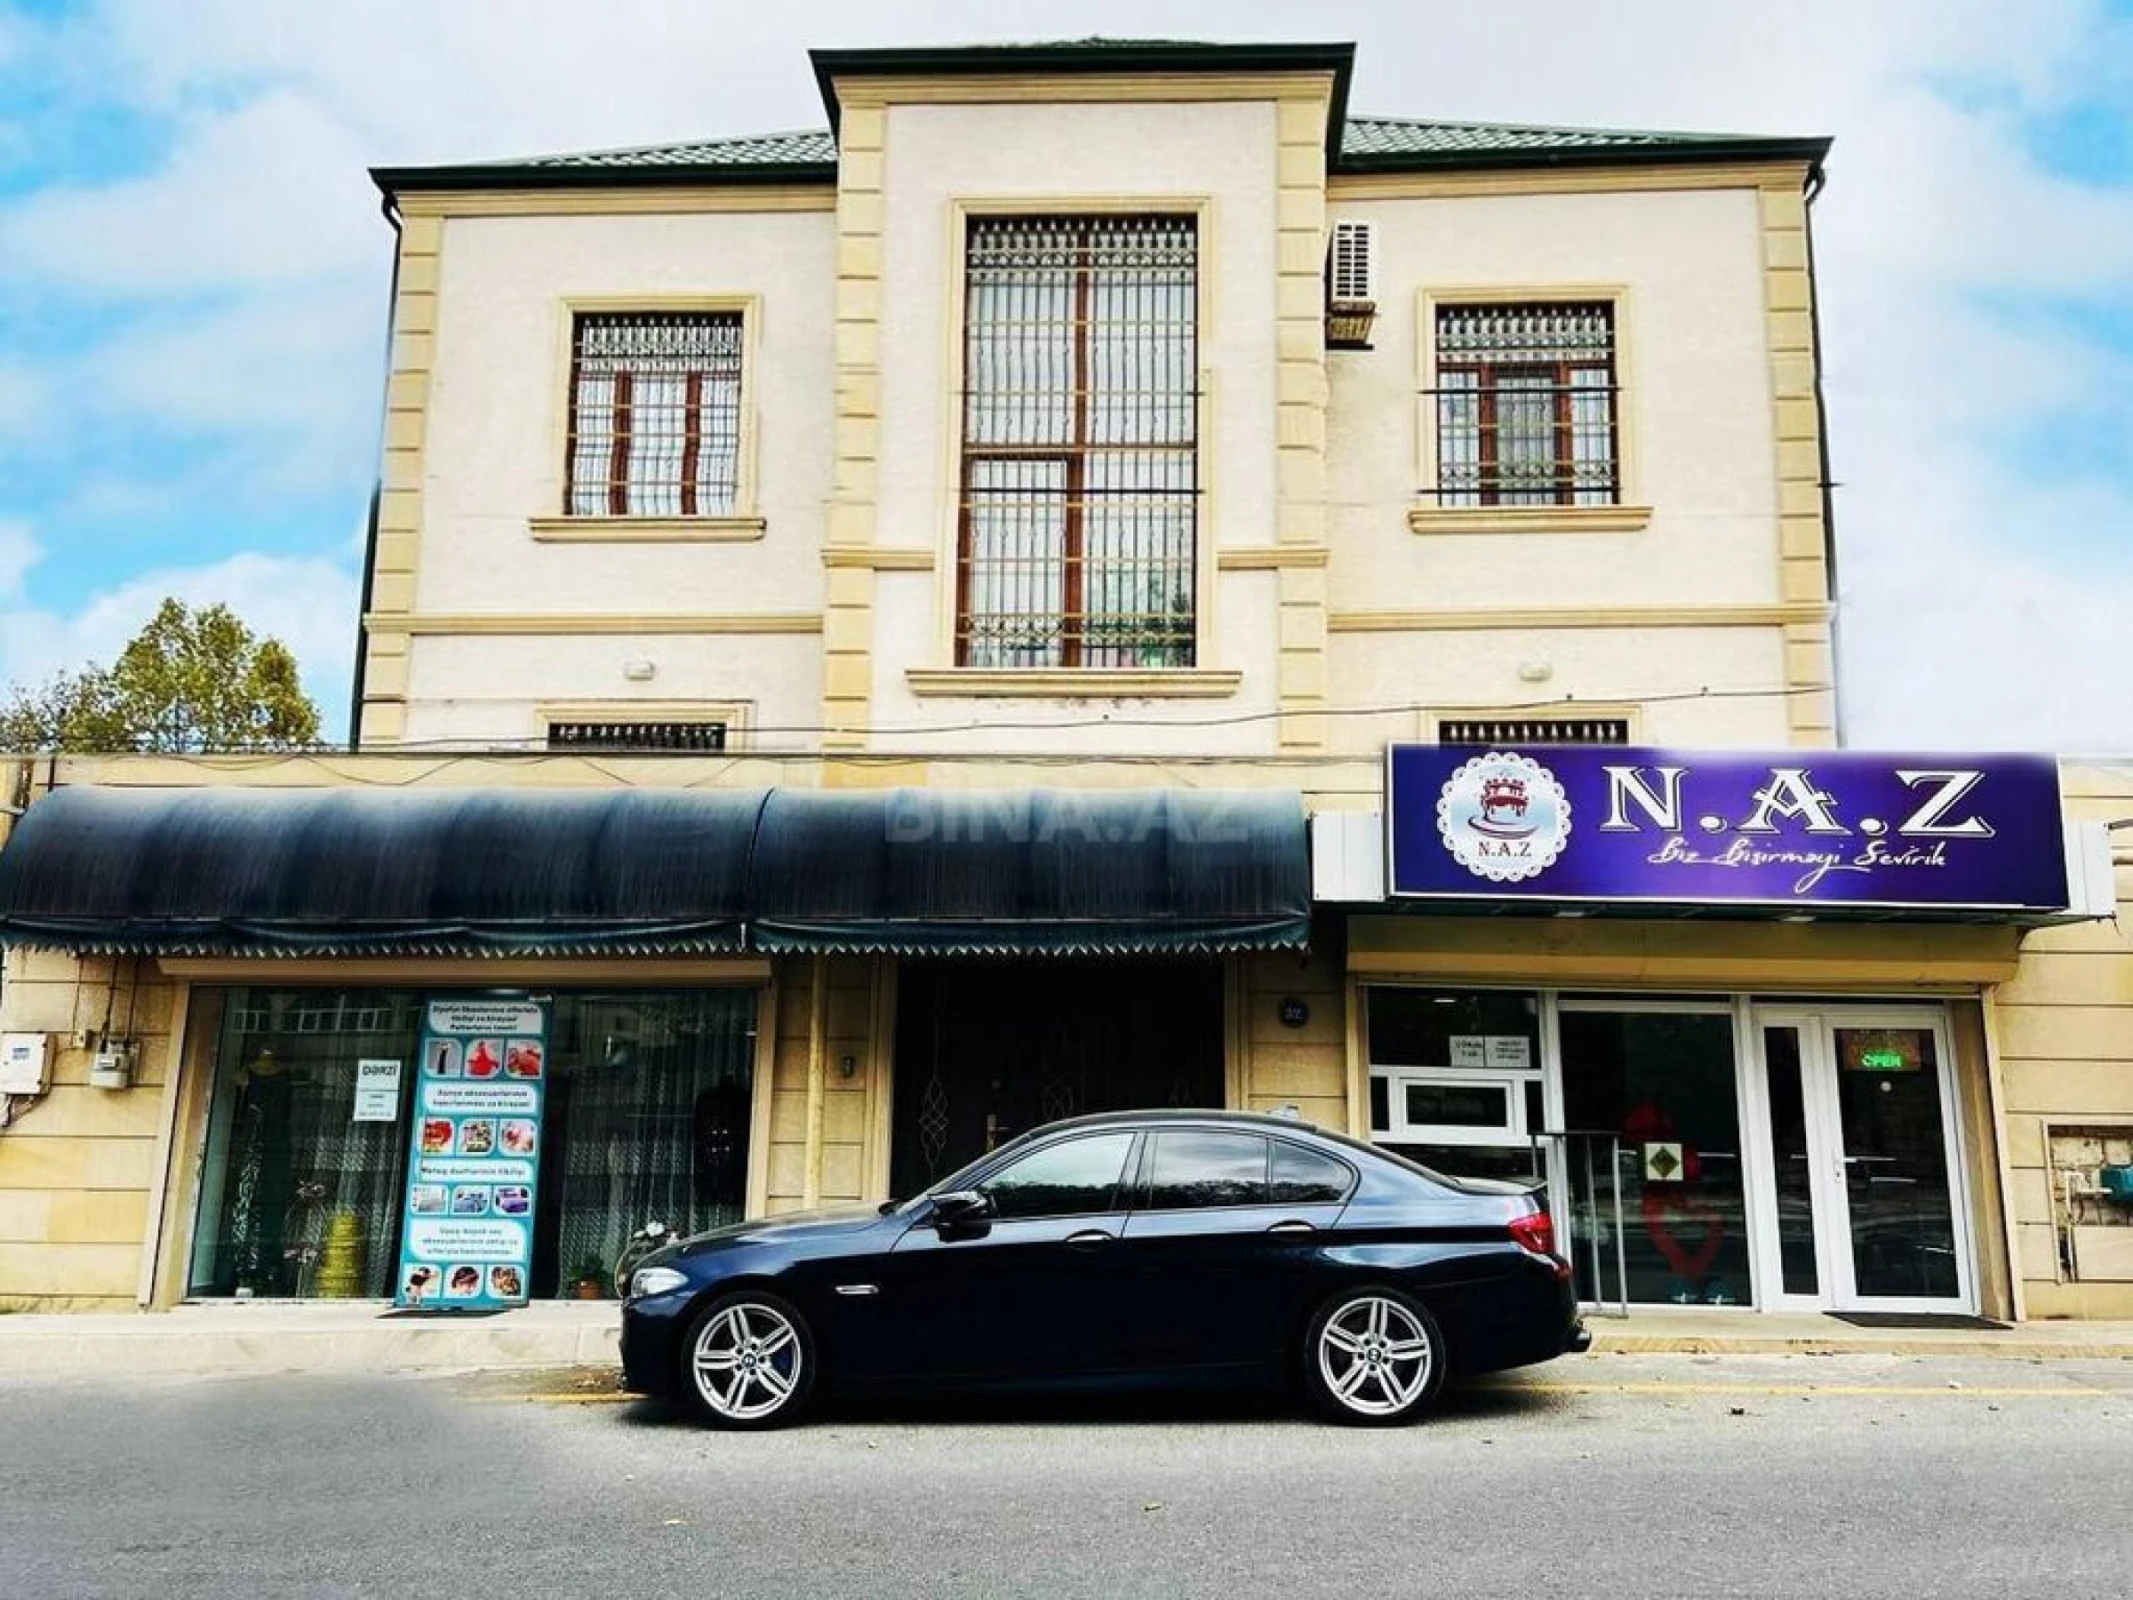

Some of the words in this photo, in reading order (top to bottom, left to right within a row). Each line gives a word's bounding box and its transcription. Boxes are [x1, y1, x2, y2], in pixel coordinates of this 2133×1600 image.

[1600, 766, 1996, 838] N.A.Z
[1478, 841, 1532, 857] N.A.Z
[1647, 836, 1701, 864] Biz
[1861, 1053, 1903, 1068] OPEN
